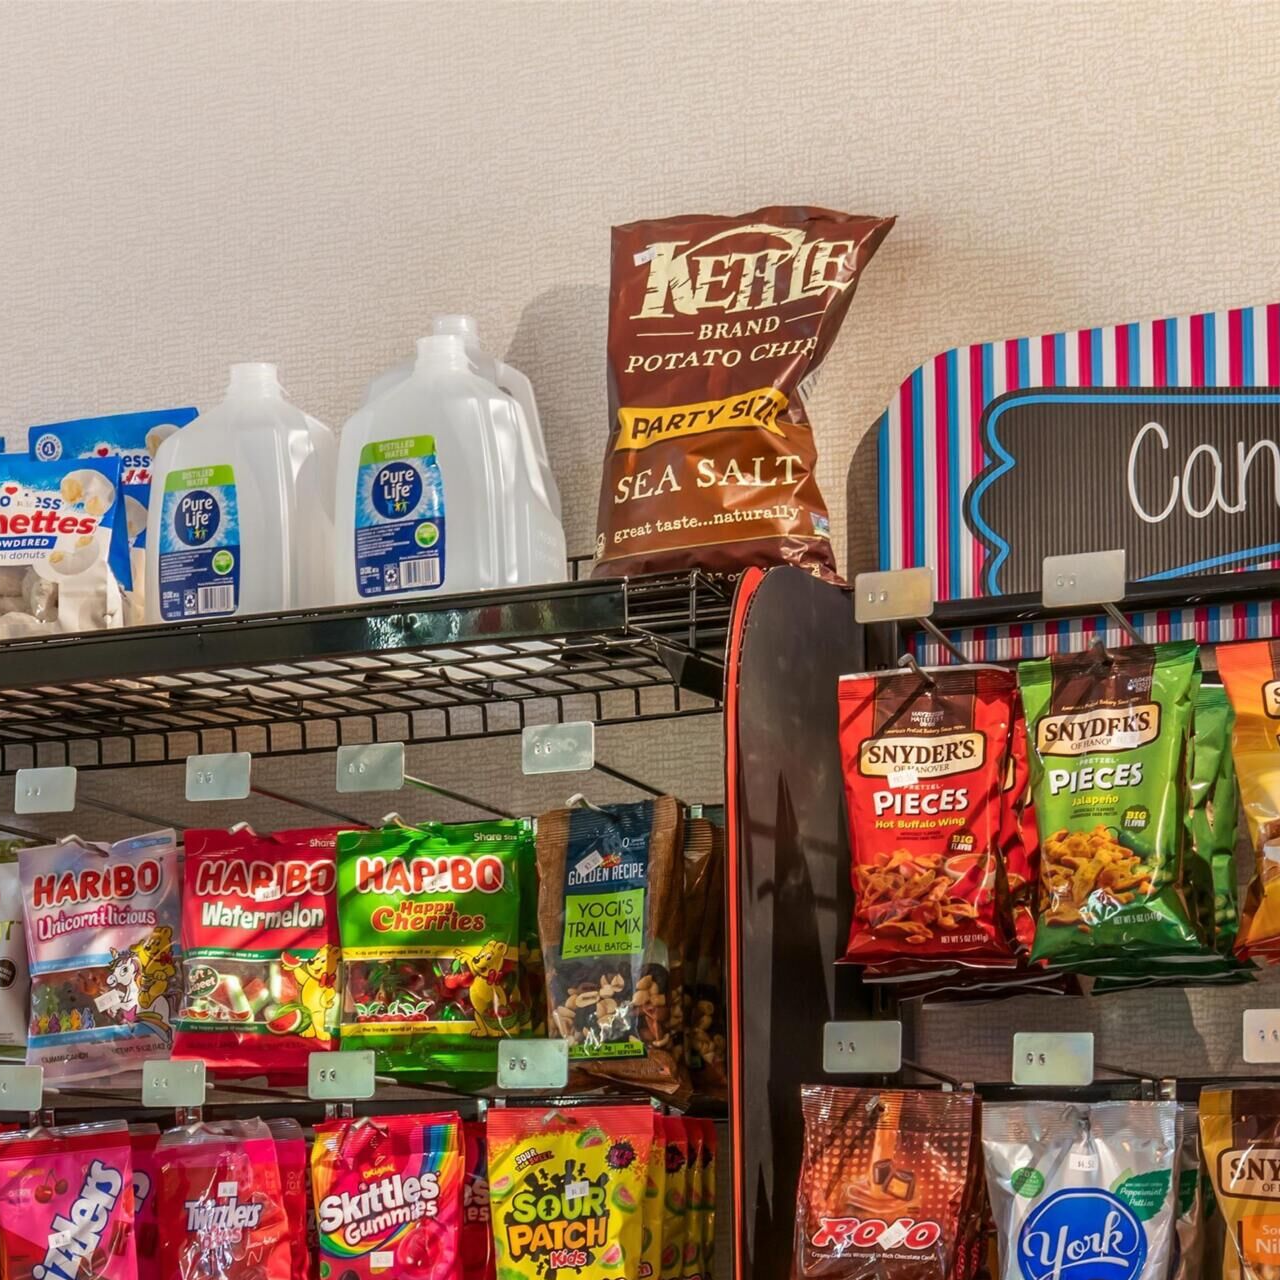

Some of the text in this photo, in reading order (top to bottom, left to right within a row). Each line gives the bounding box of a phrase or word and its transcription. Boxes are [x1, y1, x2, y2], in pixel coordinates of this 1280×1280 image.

[698, 315, 780, 340] BRAND
[380, 468, 414, 485] Pure
[614, 455, 803, 504] SEA SALT
[384, 484, 411, 500] Life
[182, 497, 213, 513] Pure
[186, 512, 209, 527] Life
[9, 551, 46, 559] donuts
[868, 740, 975, 765] SNYDER'S
[1049, 762, 1143, 794] PIECES
[873, 789, 968, 815] PIECES
[1072, 794, 1118, 806] Jalapeño
[875, 817, 965, 829] Hot Buffalo Wing
[1126, 810, 1146, 819] BIG
[953, 835, 973, 844] BIG
[202, 901, 324, 930] Watermelon
[400, 901, 454, 918] Happy
[578, 899, 634, 920] YOGI'S
[372, 907, 484, 932] Cherries
[568, 917, 640, 939] TRAIL MIX
[574, 942, 632, 953] SMALL BATCH
[1261, 1183, 1274, 1192] OF
[321, 1170, 439, 1231] Skittles
[509, 1217, 607, 1253] PATCH
[550, 1250, 587, 1268] Kids
